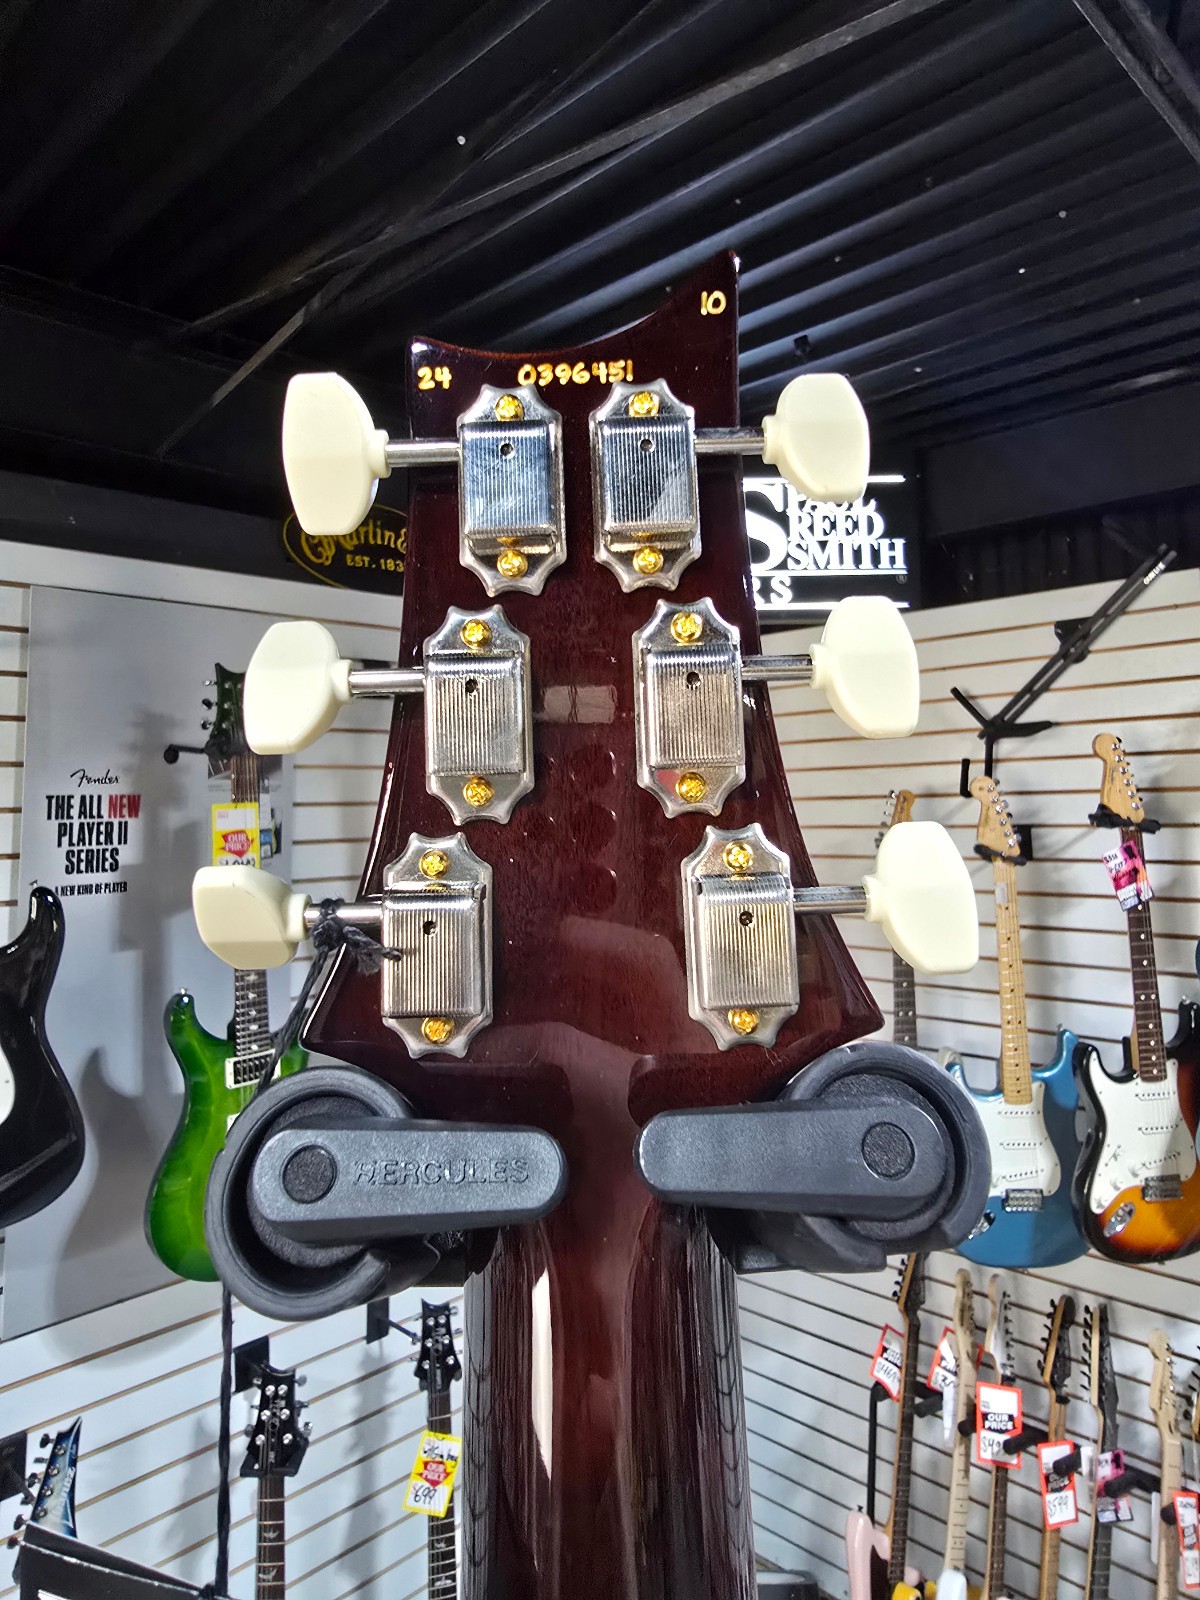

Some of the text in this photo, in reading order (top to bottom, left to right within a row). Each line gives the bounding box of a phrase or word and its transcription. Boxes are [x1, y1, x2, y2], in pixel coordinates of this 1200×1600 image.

[700, 290, 727, 316] 10
[417, 359, 634, 390] 24 0396451
[788, 511, 885, 541] REED
[346, 553, 406, 573] EST. 183
[787, 538, 907, 570] SMITH
[70, 768, 120, 787] Fender
[46, 794, 141, 820] THE ALL NEW
[57, 821, 114, 848] PLAYER
[65, 847, 120, 875] SERIES
[60, 885, 76, 896] NEW
[95, 883, 103, 894] OF
[104, 881, 128, 894] PLAYER
[353, 1157, 530, 1185] HERCULES
[984, 1420, 1014, 1431] PRICE
[987, 1413, 1009, 1422] OUR
